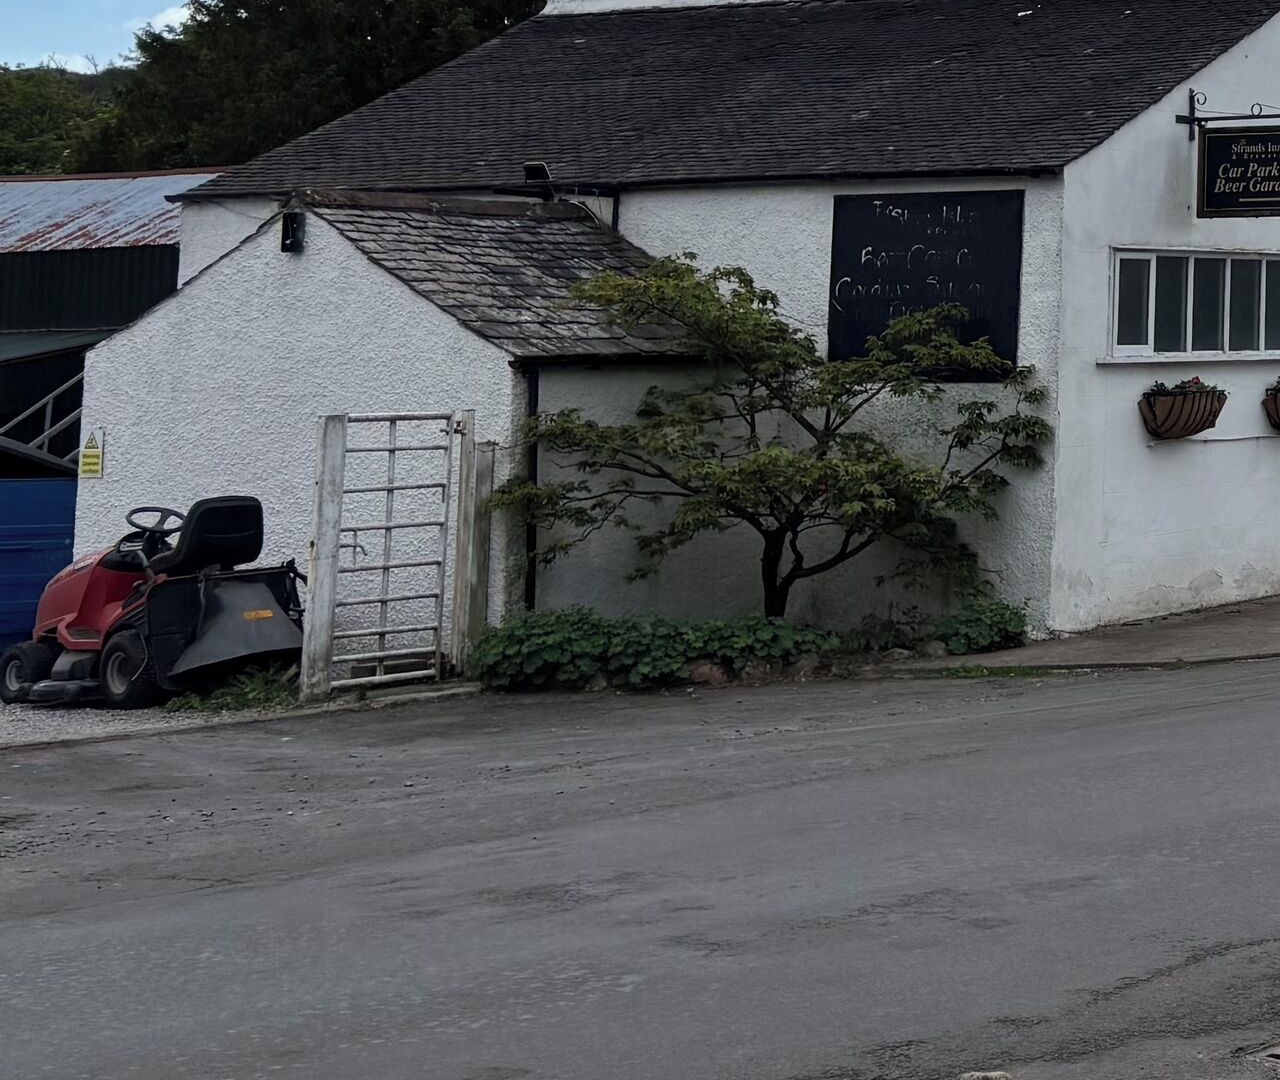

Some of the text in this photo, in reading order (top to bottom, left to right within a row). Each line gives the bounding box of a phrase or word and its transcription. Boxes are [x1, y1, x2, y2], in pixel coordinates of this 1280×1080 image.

[1231, 142, 1265, 153] Strands
[1218, 163, 1245, 178] Car
[1247, 161, 1280, 177] Park
[1214, 177, 1247, 193] Beer
